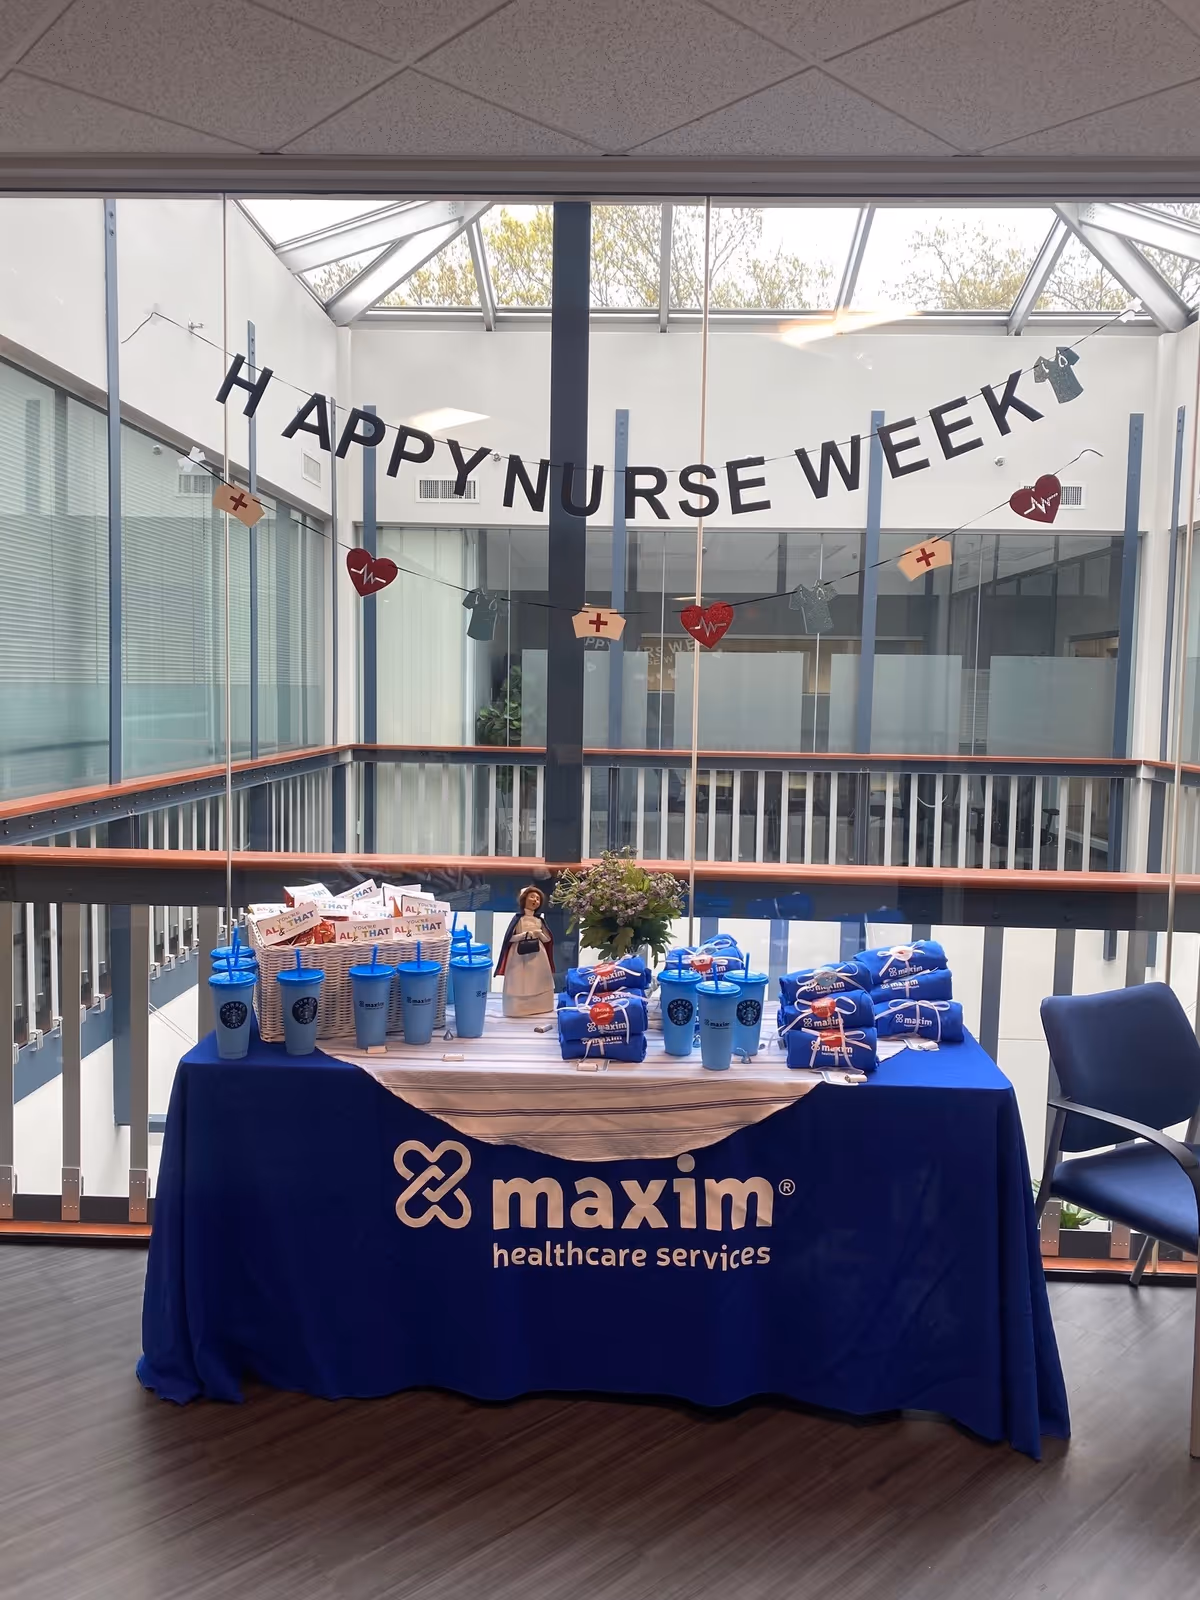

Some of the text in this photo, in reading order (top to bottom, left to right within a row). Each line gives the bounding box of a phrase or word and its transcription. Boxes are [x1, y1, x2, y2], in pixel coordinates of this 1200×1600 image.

[503, 454, 771, 520] NURSE
[794, 369, 1045, 499] WEEK
[287, 910, 315, 927] THAT
[361, 928, 390, 938] THAT
[415, 922, 442, 932] THAT
[890, 979, 919, 987] maxm
[493, 1241, 771, 1272] healthcare services
